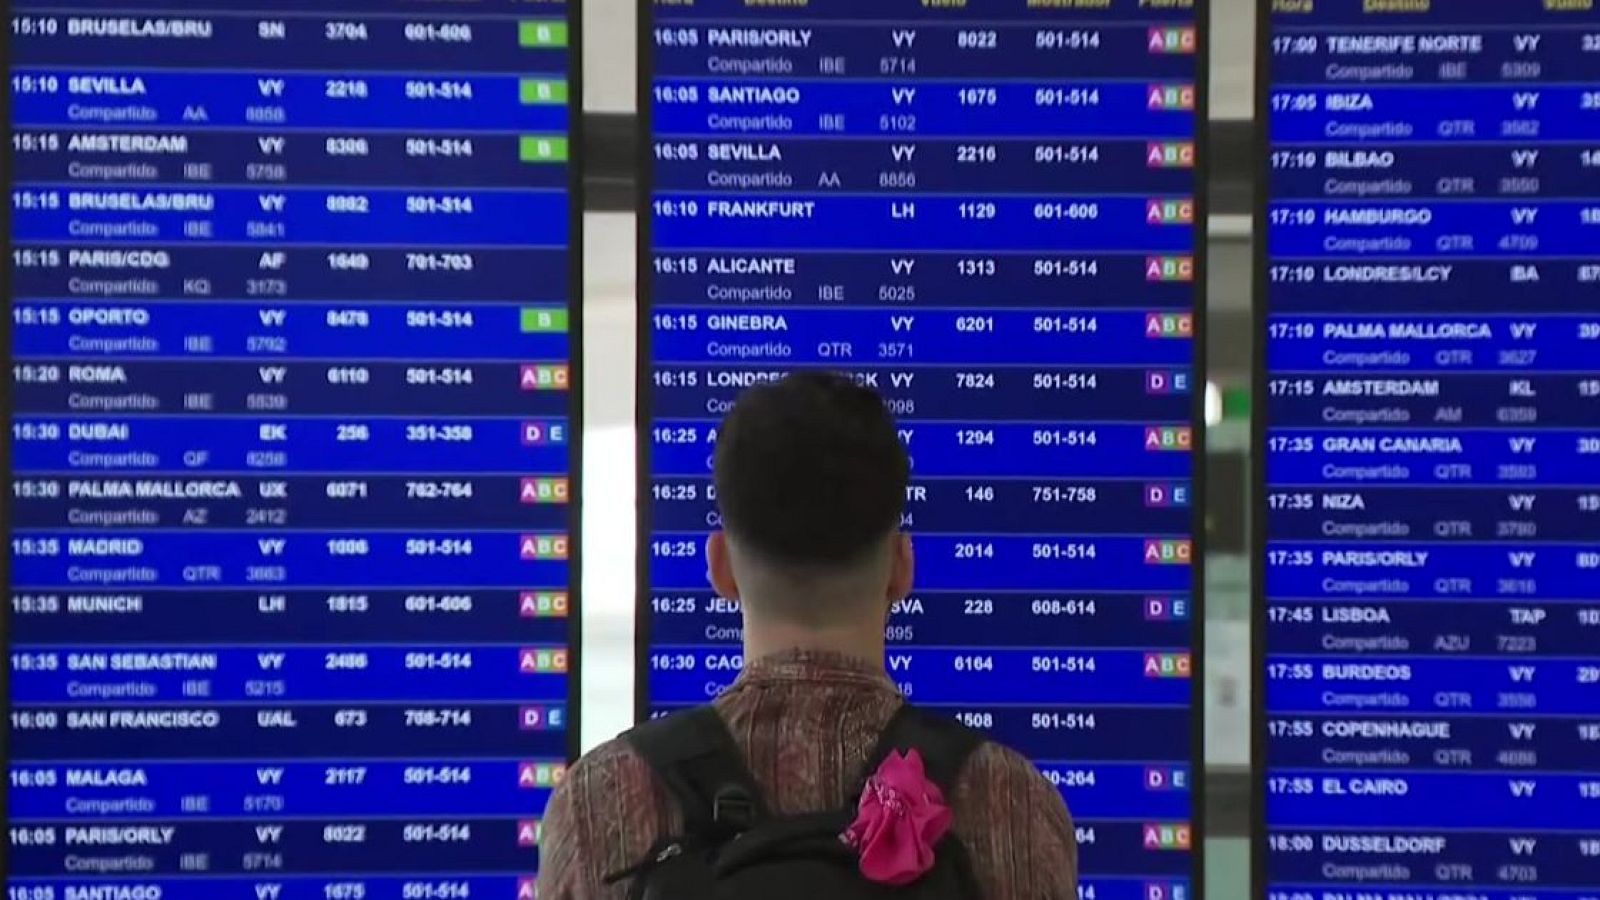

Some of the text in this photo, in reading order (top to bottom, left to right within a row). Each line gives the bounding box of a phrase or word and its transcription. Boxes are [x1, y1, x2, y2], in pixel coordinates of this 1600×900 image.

[12, 18, 285, 38] 15:10 BRUSELAS/BRU SN
[655, 29, 1099, 48] 16:05 PARIS/ORLY VY 8022 501-514
[1273, 36, 1482, 53] 17:00 TENERIFE NORTE
[708, 57, 915, 73] Compartido IBE 5714
[13, 76, 284, 95] 15:10 SEVILLA VY
[655, 87, 1098, 104] 16:05 SANTIAGO VY 1675 501-514
[1273, 94, 1372, 110] 17:05 IBIZA
[708, 116, 915, 130] Compartido IBE 5102
[13, 134, 187, 152] 15:15 AMSTERDAM
[655, 143, 1098, 162] 16:05 SEVILLA VY 2216 501-514
[1273, 151, 1394, 167] 17:10 BILBAO
[69, 163, 157, 179] Compartido
[708, 172, 792, 187] Compartido
[819, 173, 840, 186] AA
[14, 192, 214, 210] 15:15 BRUSELAS/BRU
[654, 201, 1098, 218] 16:10 FRANKFURT LH 1129 601-606
[1272, 209, 1431, 224] 17:10 HAMBURGO
[13, 250, 472, 270] 15:15 PARIS/CDG AF 701-703
[654, 258, 1097, 275] 16:15 ALICANTE VY 1313 501-514
[1271, 266, 1314, 281] 17:10
[708, 285, 914, 301] Compartido IBE 5025
[14, 308, 551, 328] 15:15 OPORTO 501-514 B
[654, 315, 1096, 331] 16:15 GINEBRA VY 6201 501-514
[1270, 323, 1491, 338] 17:10 PALMA MALLORCA
[708, 343, 913, 357] Compartido QTR 3571
[13, 366, 286, 383] 15:20 ROMA VY
[654, 371, 1096, 388] 16:15 VY 7824 501-514
[1270, 380, 1439, 395] 17:15 AMSTERDAM
[14, 424, 286, 440] 15:30 DUBAI EK
[654, 429, 696, 442] 16:25
[957, 430, 993, 444] 1294
[1034, 431, 1096, 445] 501-514
[1270, 437, 1463, 452] 17:35 GRAN CANARIA
[14, 481, 287, 497] 15:30 PALMA MALLORCA UX
[653, 485, 696, 499] 16:25
[966, 487, 993, 501] 146
[1033, 487, 1096, 501] 751-758
[1269, 494, 1535, 510] 17:35 NIZA VY
[13, 539, 143, 554] 15:35 MADRID
[653, 542, 1095, 558] 16:25 2014 501-514
[1269, 551, 1427, 566] 17:35 PARIS/ORLY
[13, 596, 285, 612] 15:35 MUNICH LH
[652, 598, 1095, 615] 16:25 228 608-614
[1269, 607, 1545, 624] 17:45 LISBOA TAP
[13, 653, 217, 670] 15:35 SAN SEBASTIAN
[652, 655, 1095, 671] 16:30 VY 6164 501-514
[1269, 664, 1411, 680] 17:55 BURDEOS
[12, 711, 296, 728] 16:00 SAN FRANCISCO UAL
[1032, 713, 1095, 728] 501-514
[1269, 721, 1449, 737] 17:55 COPENHAGUE
[11, 769, 282, 786] 16:05 MALAGA VY
[1270, 778, 1408, 794] 17:55 EL CAIRO
[10, 827, 174, 844] 16:05 PARIS/ORLY
[1270, 836, 1536, 854] 18:00 DUSSELDORF VY
[65, 886, 161, 900] SANTIAGO
